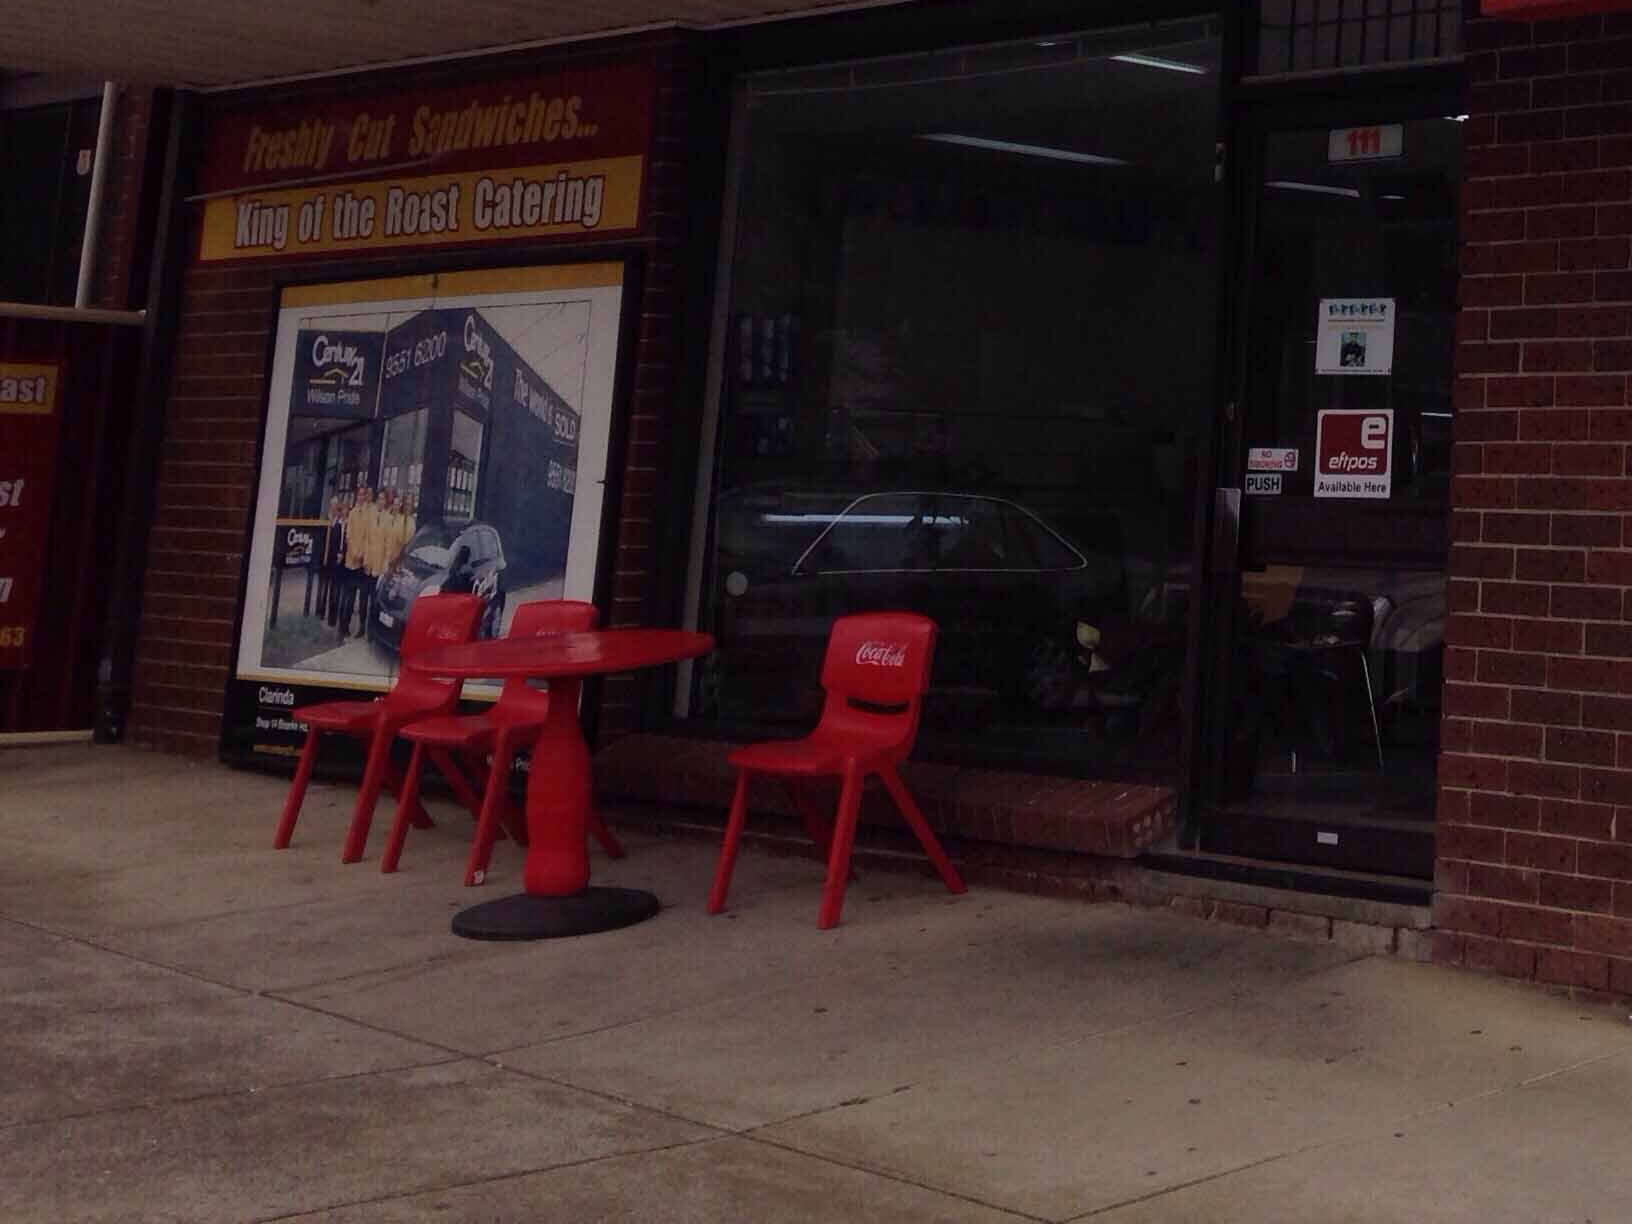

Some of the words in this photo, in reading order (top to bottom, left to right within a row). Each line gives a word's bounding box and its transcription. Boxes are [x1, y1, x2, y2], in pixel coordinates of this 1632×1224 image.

[244, 118, 335, 173] Freshly
[348, 112, 396, 162] Cut
[234, 194, 290, 250] King
[299, 194, 326, 244] of
[332, 189, 375, 241] the
[384, 183, 462, 238] Roast
[473, 172, 605, 230] Catering
[1328, 451, 1378, 471] eftpos
[1247, 478, 1280, 491] PUSH
[1318, 481, 1361, 494] Available
[1364, 482, 1387, 494] Here
